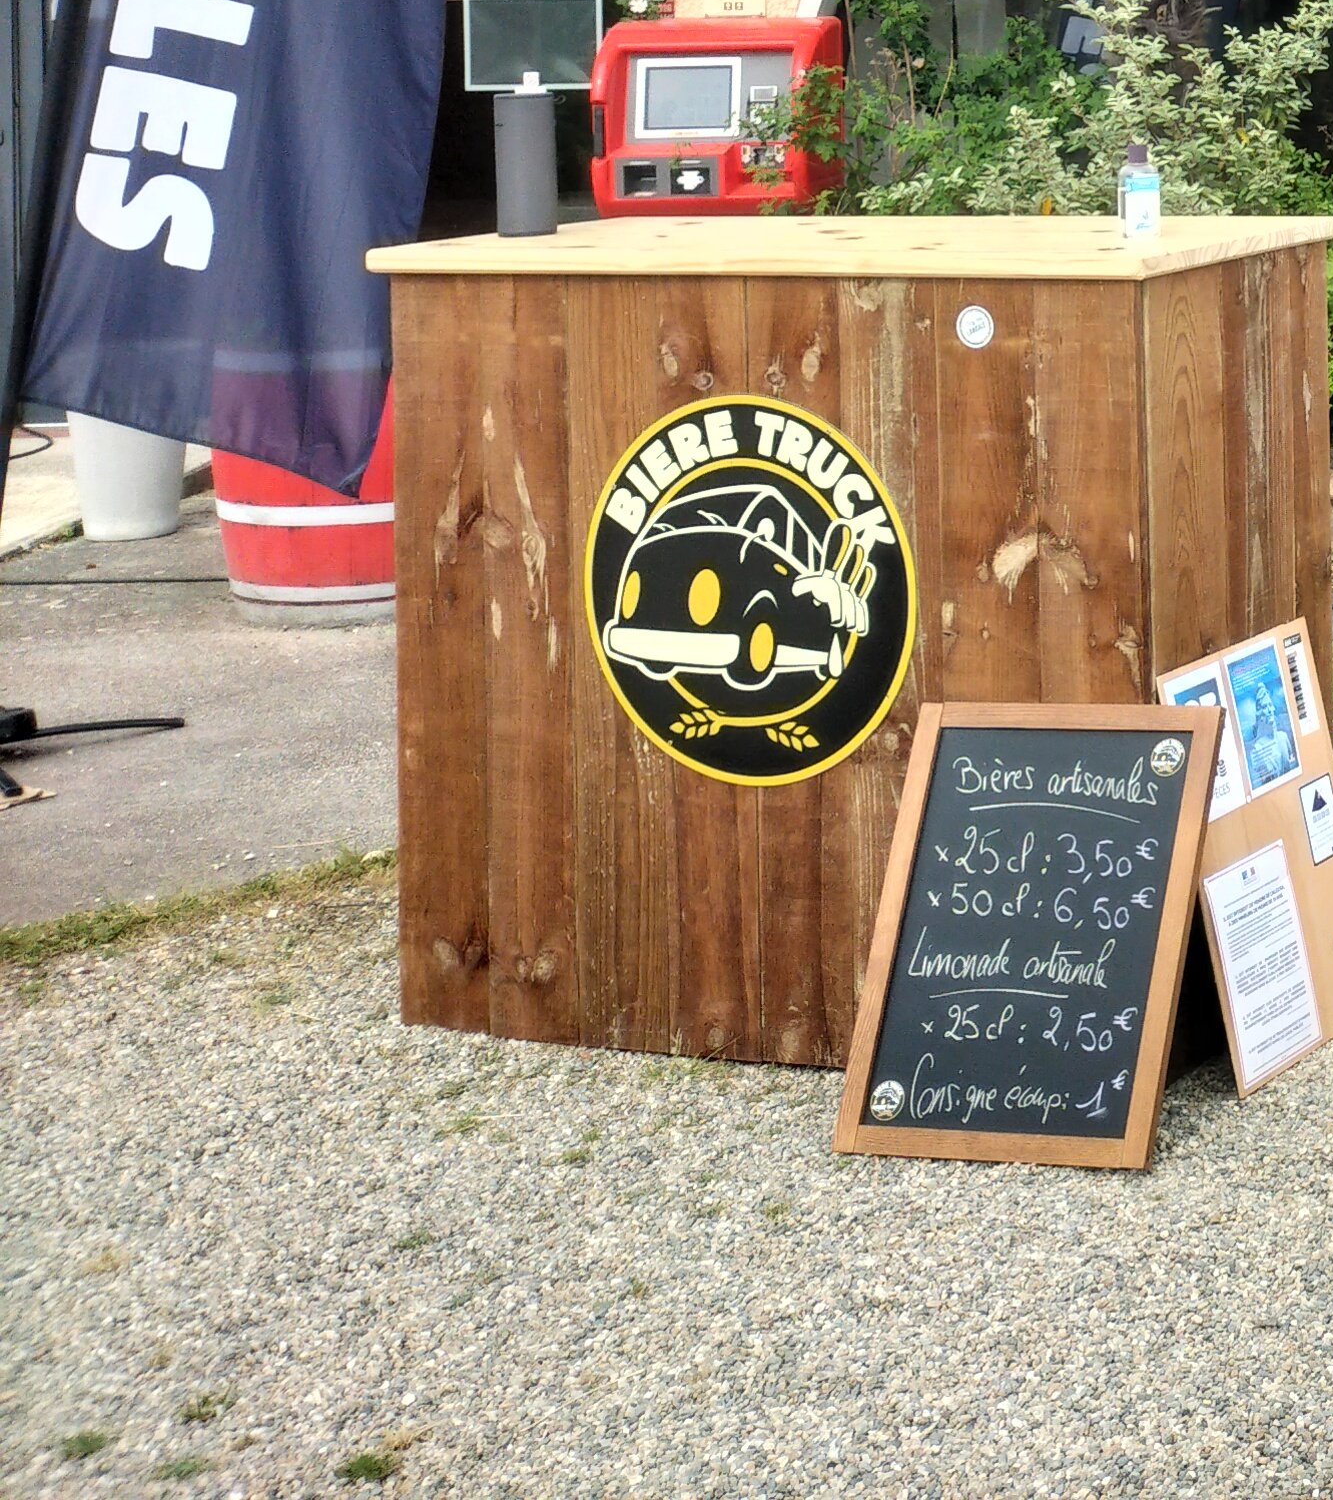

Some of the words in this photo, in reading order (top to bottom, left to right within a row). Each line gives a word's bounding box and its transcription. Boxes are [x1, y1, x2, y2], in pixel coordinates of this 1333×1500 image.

[605, 409, 739, 535] BIERE
[754, 411, 896, 548] TRUCK
[952, 756, 1035, 794] Bières
[1047, 756, 1159, 806] artisanales
[908, 926, 1010, 980] Limonade
[1023, 938, 1116, 988] artisanale
[909, 1053, 998, 1124] Consigne
